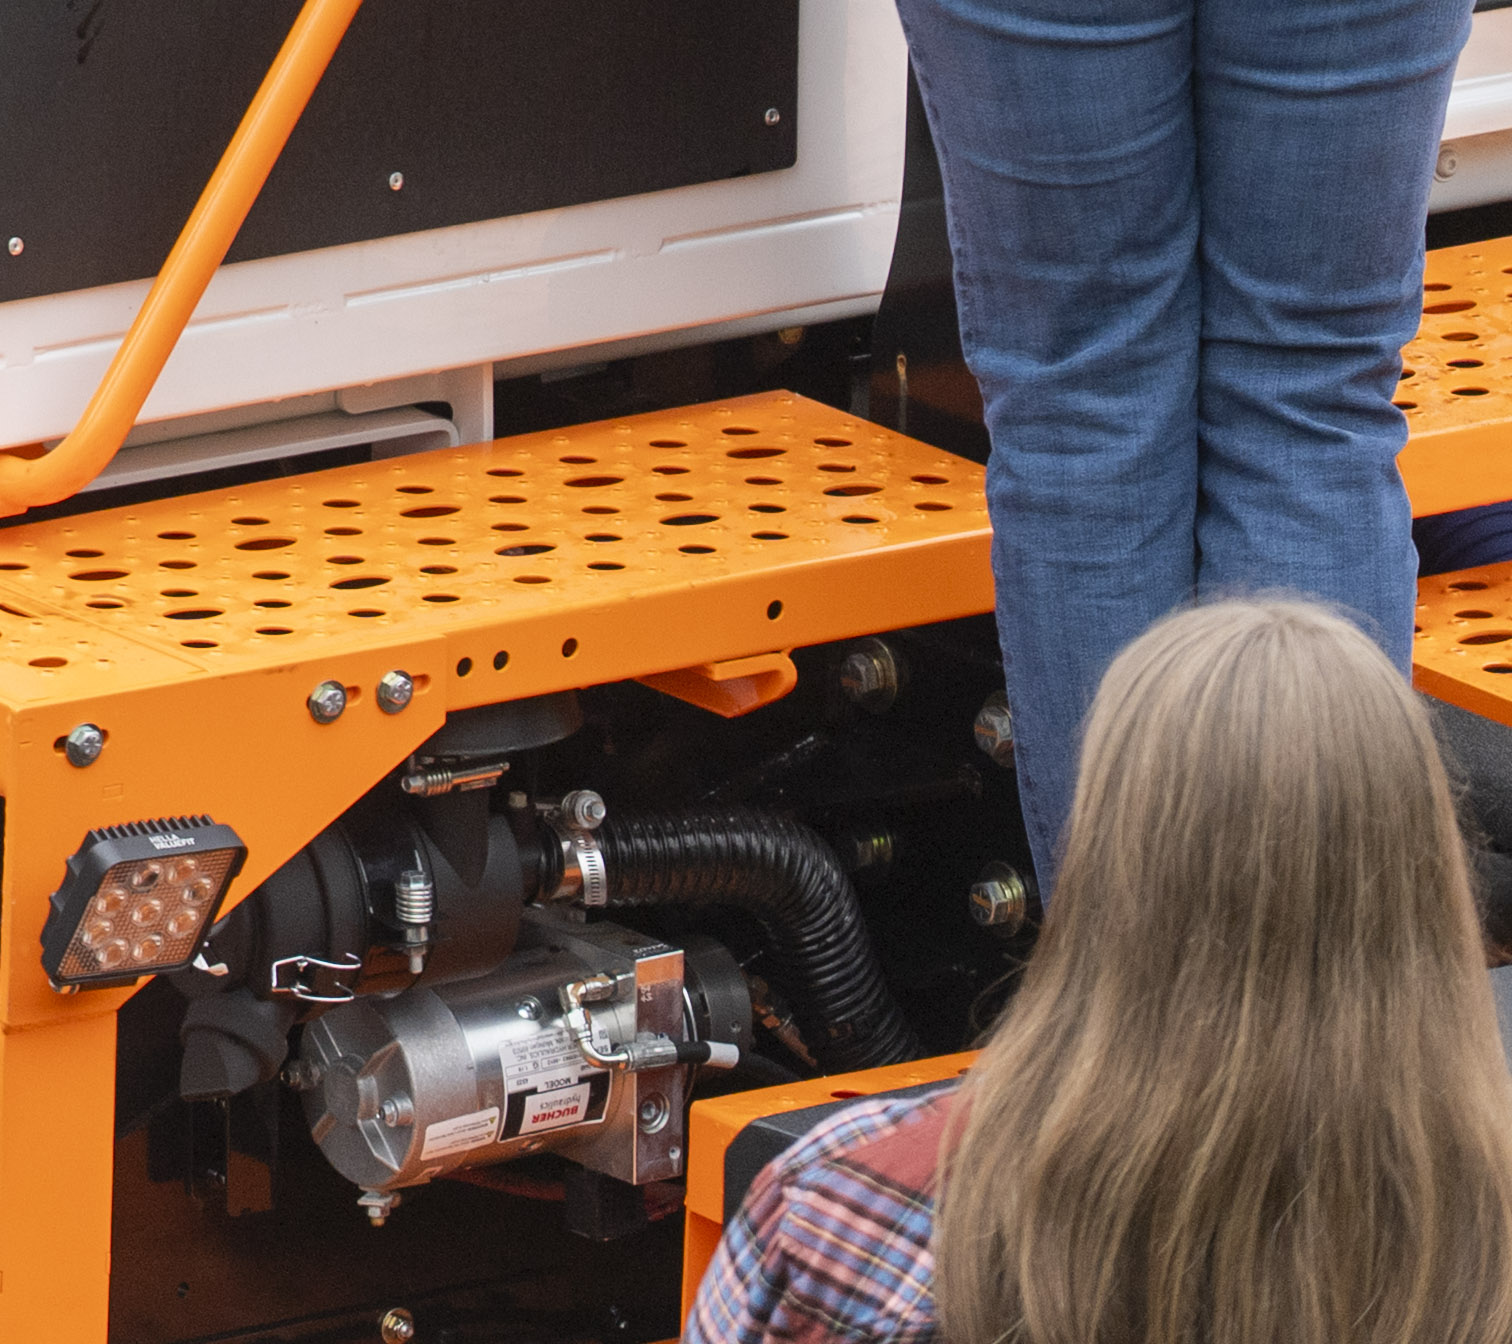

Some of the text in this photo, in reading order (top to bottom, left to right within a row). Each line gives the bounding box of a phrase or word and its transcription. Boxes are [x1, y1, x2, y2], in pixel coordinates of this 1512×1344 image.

[544, 1077, 572, 1089] MODEL
[539, 1093, 581, 1110] hydraulics
[531, 1105, 579, 1124] BUCHER
